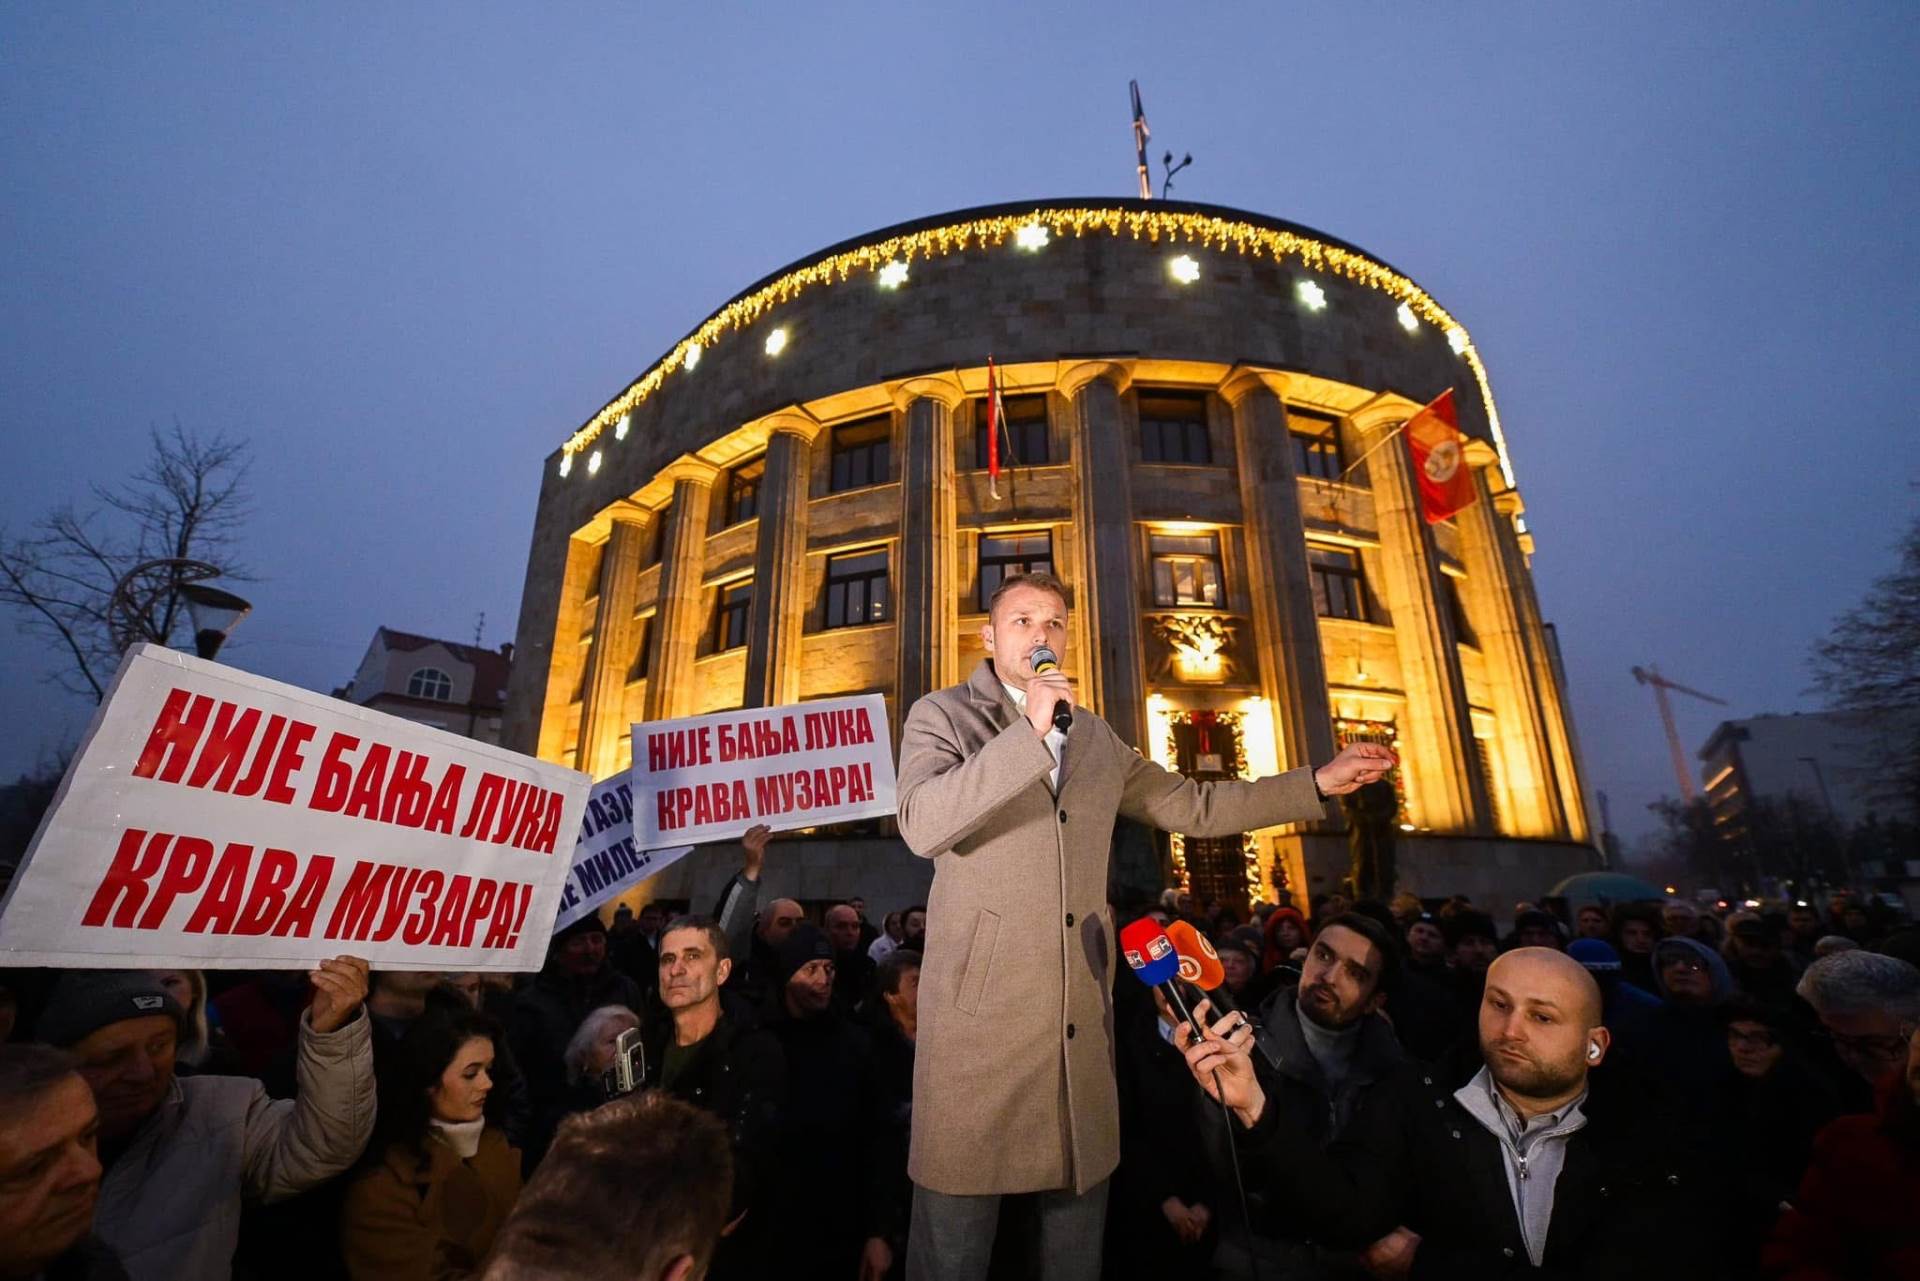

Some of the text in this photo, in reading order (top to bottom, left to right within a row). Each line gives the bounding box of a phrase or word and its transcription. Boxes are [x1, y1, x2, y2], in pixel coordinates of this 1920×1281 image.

[133, 688, 564, 855] НИЈЕ БАЊА ЛУКА
[648, 707, 874, 773] НИЈЕ БАЊА ЛУКА
[657, 762, 875, 831] КРАВА МУЗАРА!
[81, 828, 534, 949] КРАВА МУЗАРА!
